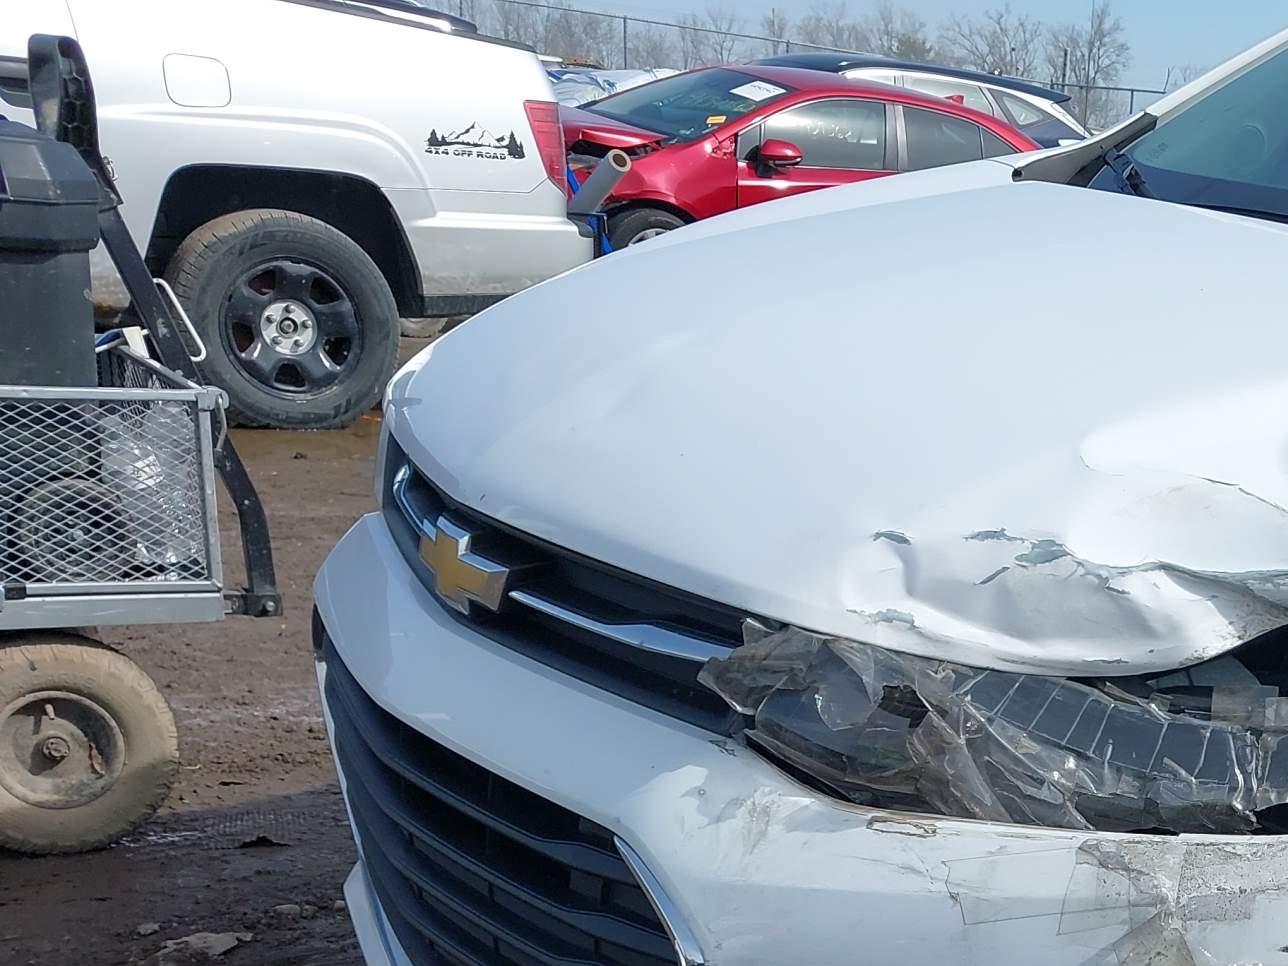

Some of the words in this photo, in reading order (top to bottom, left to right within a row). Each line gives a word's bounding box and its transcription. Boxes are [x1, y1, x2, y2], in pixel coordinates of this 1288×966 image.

[425, 147, 449, 156] 4X4
[453, 149, 473, 158] OFF
[476, 151, 507, 160] ROAD
